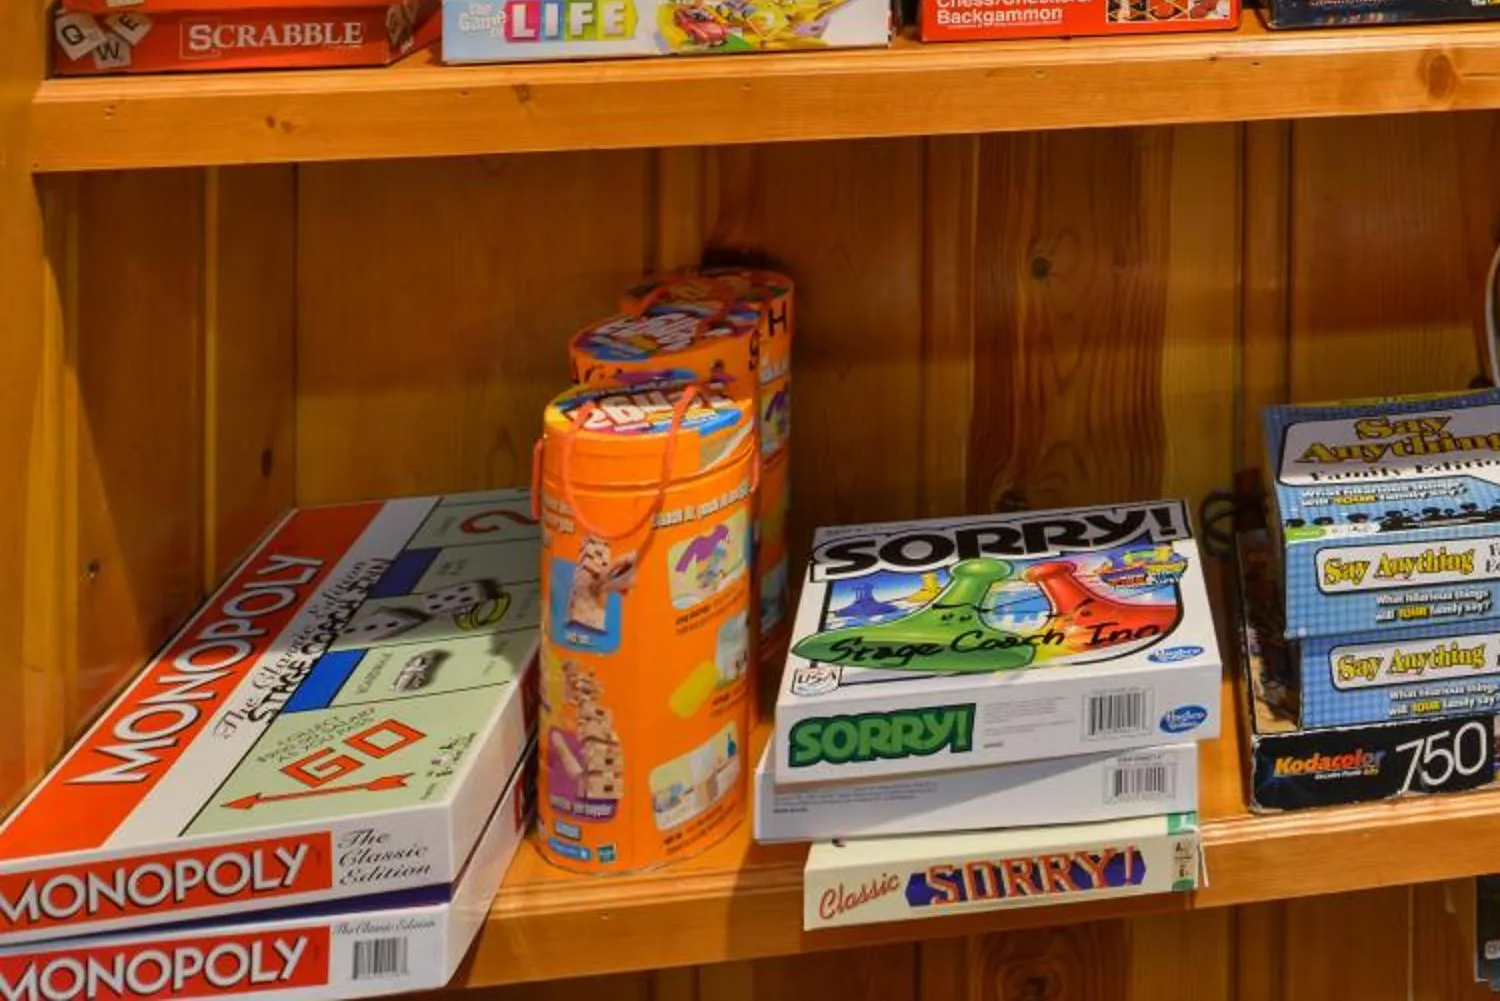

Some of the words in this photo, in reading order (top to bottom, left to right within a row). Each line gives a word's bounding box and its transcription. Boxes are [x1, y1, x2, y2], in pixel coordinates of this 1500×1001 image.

[60, 23, 88, 47] Q
[188, 22, 364, 52] SCRABBLE
[511, 1, 626, 39] LIFE
[936, 6, 1064, 29] Backgammon
[1353, 415, 1453, 441] Say
[824, 506, 1178, 574] SORRY!
[1322, 556, 1371, 586] Say
[1374, 546, 1477, 580] Anything
[829, 635, 946, 665] Stage
[949, 628, 1066, 653] Coach
[1078, 621, 1163, 647] Inn
[1336, 654, 1384, 682] Say
[1387, 640, 1487, 675] Anything
[64, 553, 326, 783] MONOPOLY
[279, 718, 428, 789] GO
[790, 707, 974, 765] SORRY!
[1273, 749, 1388, 777] Kodacolor
[1395, 720, 1488, 794] 750
[337, 827, 391, 849] The
[338, 843, 429, 867] Classic
[0, 844, 309, 923] MONOPOLY
[339, 863, 432, 886] Edition
[817, 871, 900, 921] Classic
[925, 844, 1137, 906] SORRY!
[0, 936, 309, 1001] MONOPOLY
